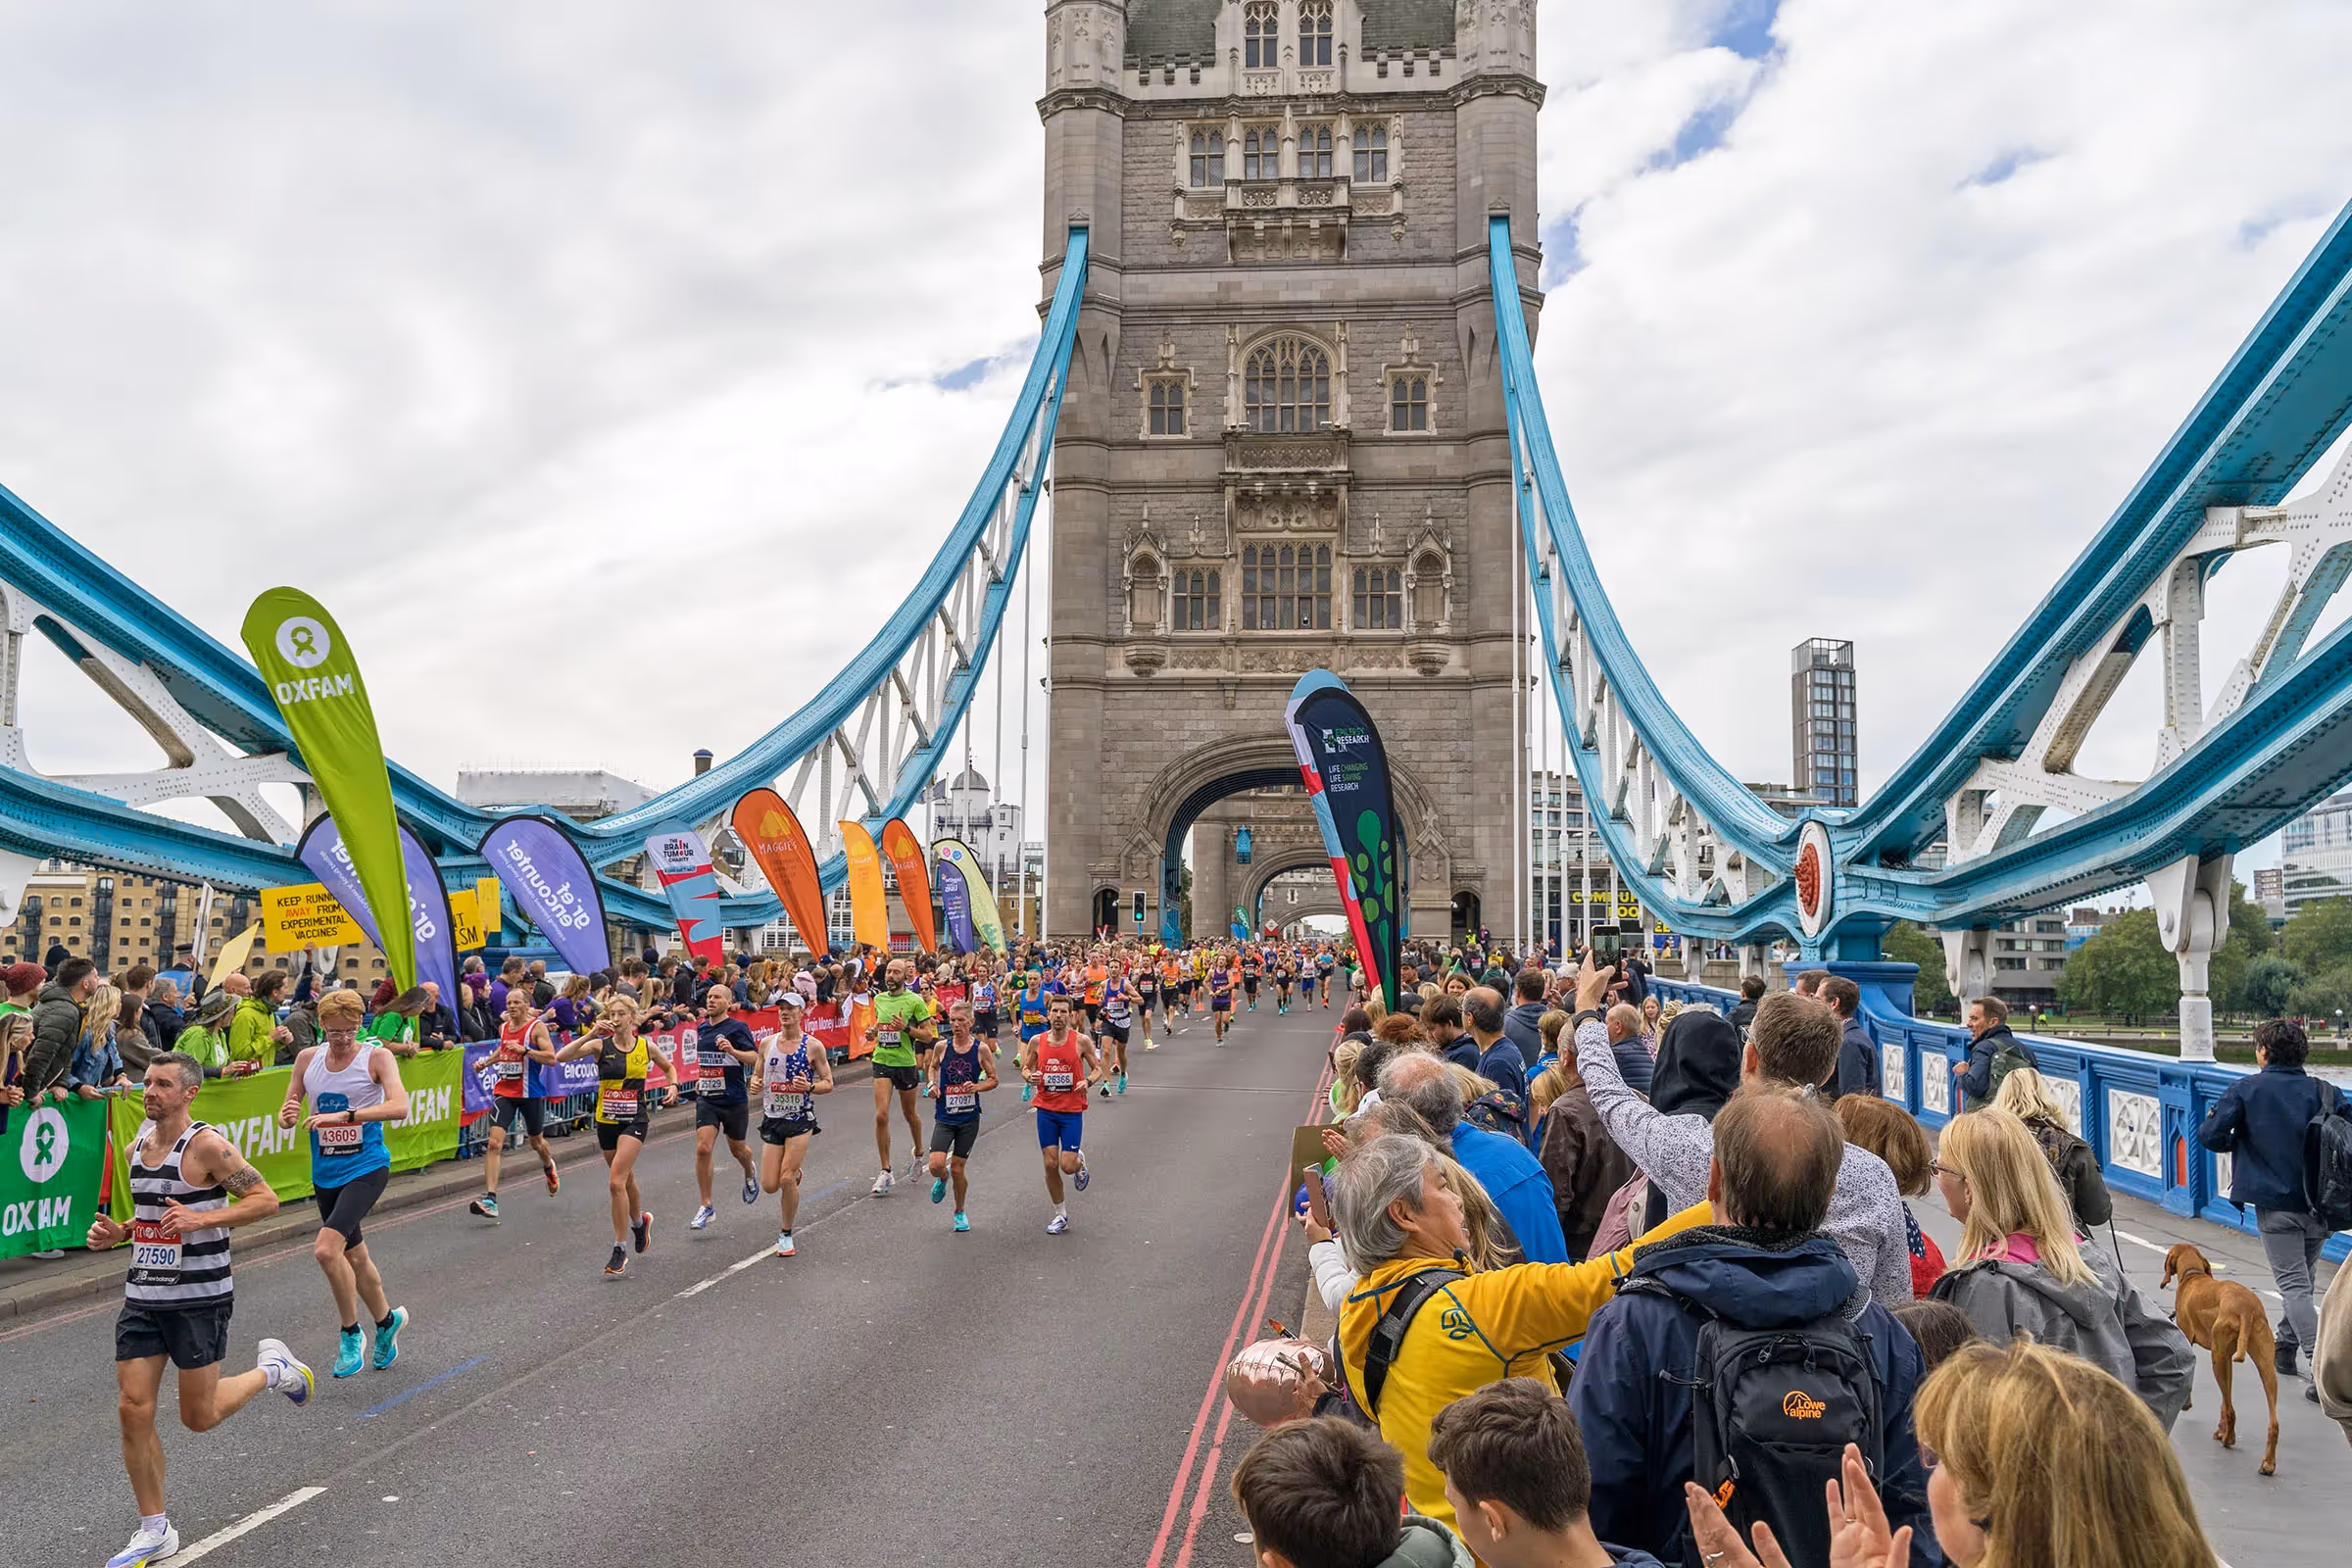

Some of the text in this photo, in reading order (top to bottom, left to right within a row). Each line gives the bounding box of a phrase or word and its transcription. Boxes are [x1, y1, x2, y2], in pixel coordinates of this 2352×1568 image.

[275, 673, 355, 705] OXFAM
[1336, 735, 1370, 745] RESEARCH
[1328, 762, 1368, 773] LIFE CHANGING
[1329, 772, 1362, 783] LIFE SAVING
[1330, 782, 1359, 792] RESEARCH
[759, 840, 798, 855] MAGGIE'S
[276, 892, 338, 907] KEEP RUNNI
[285, 903, 341, 918] AWAY FROM
[281, 915, 347, 930] EXPERIMENTAL
[804, 1017, 818, 1035] Virgin
[818, 1016, 835, 1032] Money
[702, 1079, 721, 1089] 25729
[1047, 1075, 1070, 1084] 26366
[774, 1095, 800, 1103] 35316
[950, 1096, 971, 1105] 27097
[321, 1129, 357, 1143] 43609
[137, 1247, 175, 1265] 27590
[1797, 1399, 1827, 1410] Lowe
[1789, 1407, 1822, 1420] alpine
